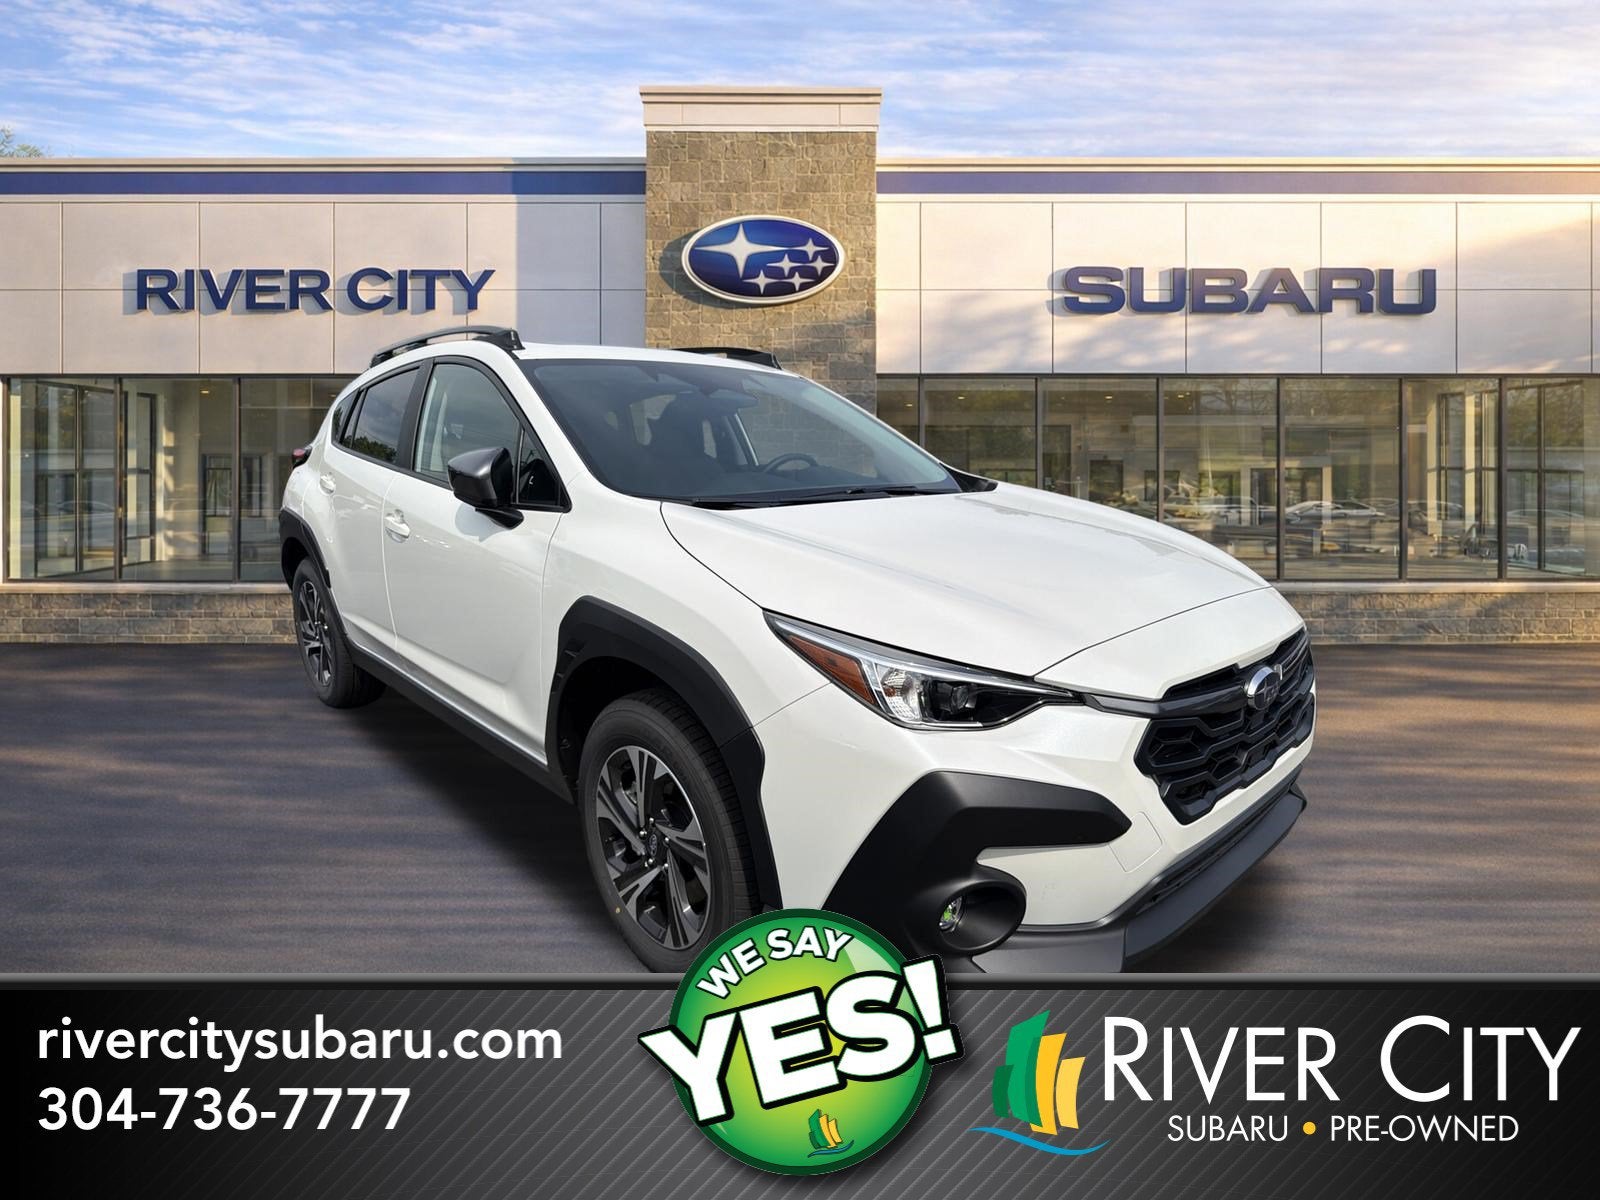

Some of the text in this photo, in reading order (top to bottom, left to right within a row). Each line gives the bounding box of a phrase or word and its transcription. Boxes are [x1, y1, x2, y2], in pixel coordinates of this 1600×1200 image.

[136, 266, 496, 311] RIVER CITY
[1063, 265, 1437, 315] SUBARU
